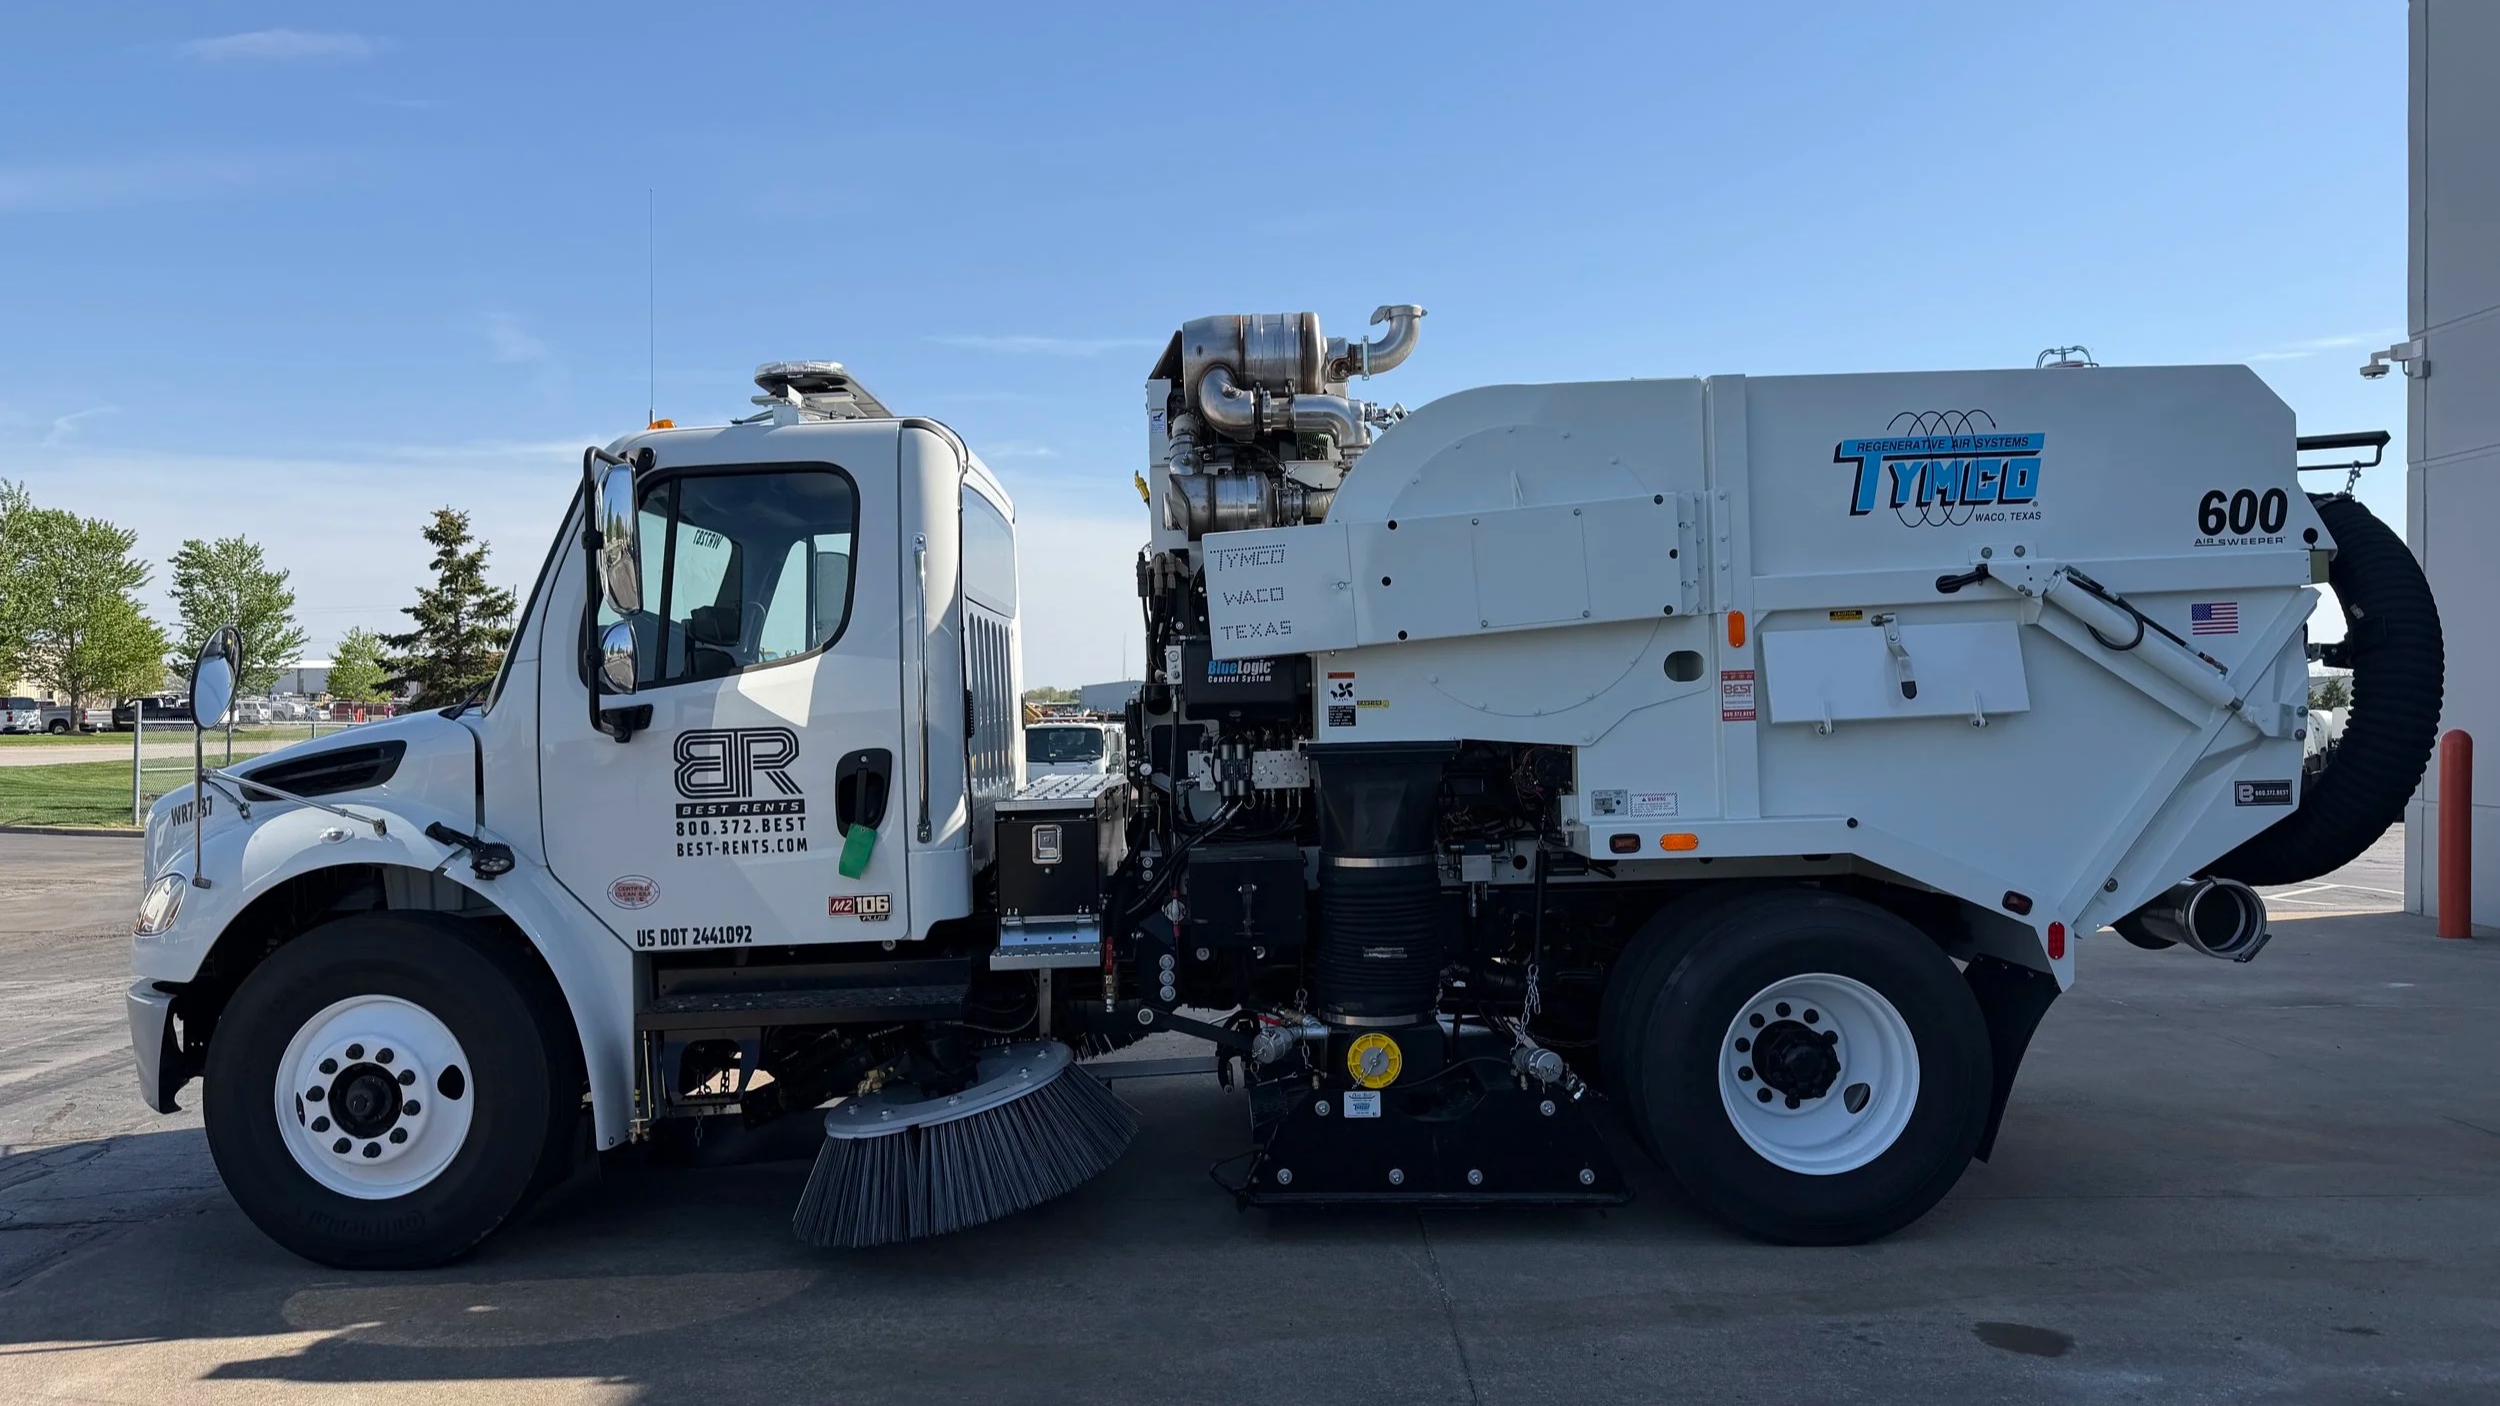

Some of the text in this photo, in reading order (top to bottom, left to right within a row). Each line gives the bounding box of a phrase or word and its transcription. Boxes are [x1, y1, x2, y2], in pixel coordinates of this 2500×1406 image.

[1857, 437, 2029, 452] REGENERATIVE AIR SYSTEMS
[1833, 432, 2046, 516] TYMCO
[1975, 511, 2041, 522] WACO, TEXAS
[2198, 488, 2288, 536] 600
[2194, 536, 2284, 547] AIR SWEEPER
[1209, 544, 1286, 571] TYMCO
[1223, 587, 1284, 605] WACO
[1220, 620, 1292, 640] TEXAS
[1208, 660, 1271, 675] BlueLogic
[1208, 675, 1272, 684] Control System
[1724, 684, 1752, 694] BEST
[171, 795, 213, 827] WR787
[682, 802, 800, 815] BEST RENTS
[676, 816, 806, 837] 800.372.BEST
[677, 837, 808, 857] BEST-RENTS.COM
[832, 896, 889, 913] M2 106
[637, 925, 752, 947] US DOT 2441092
